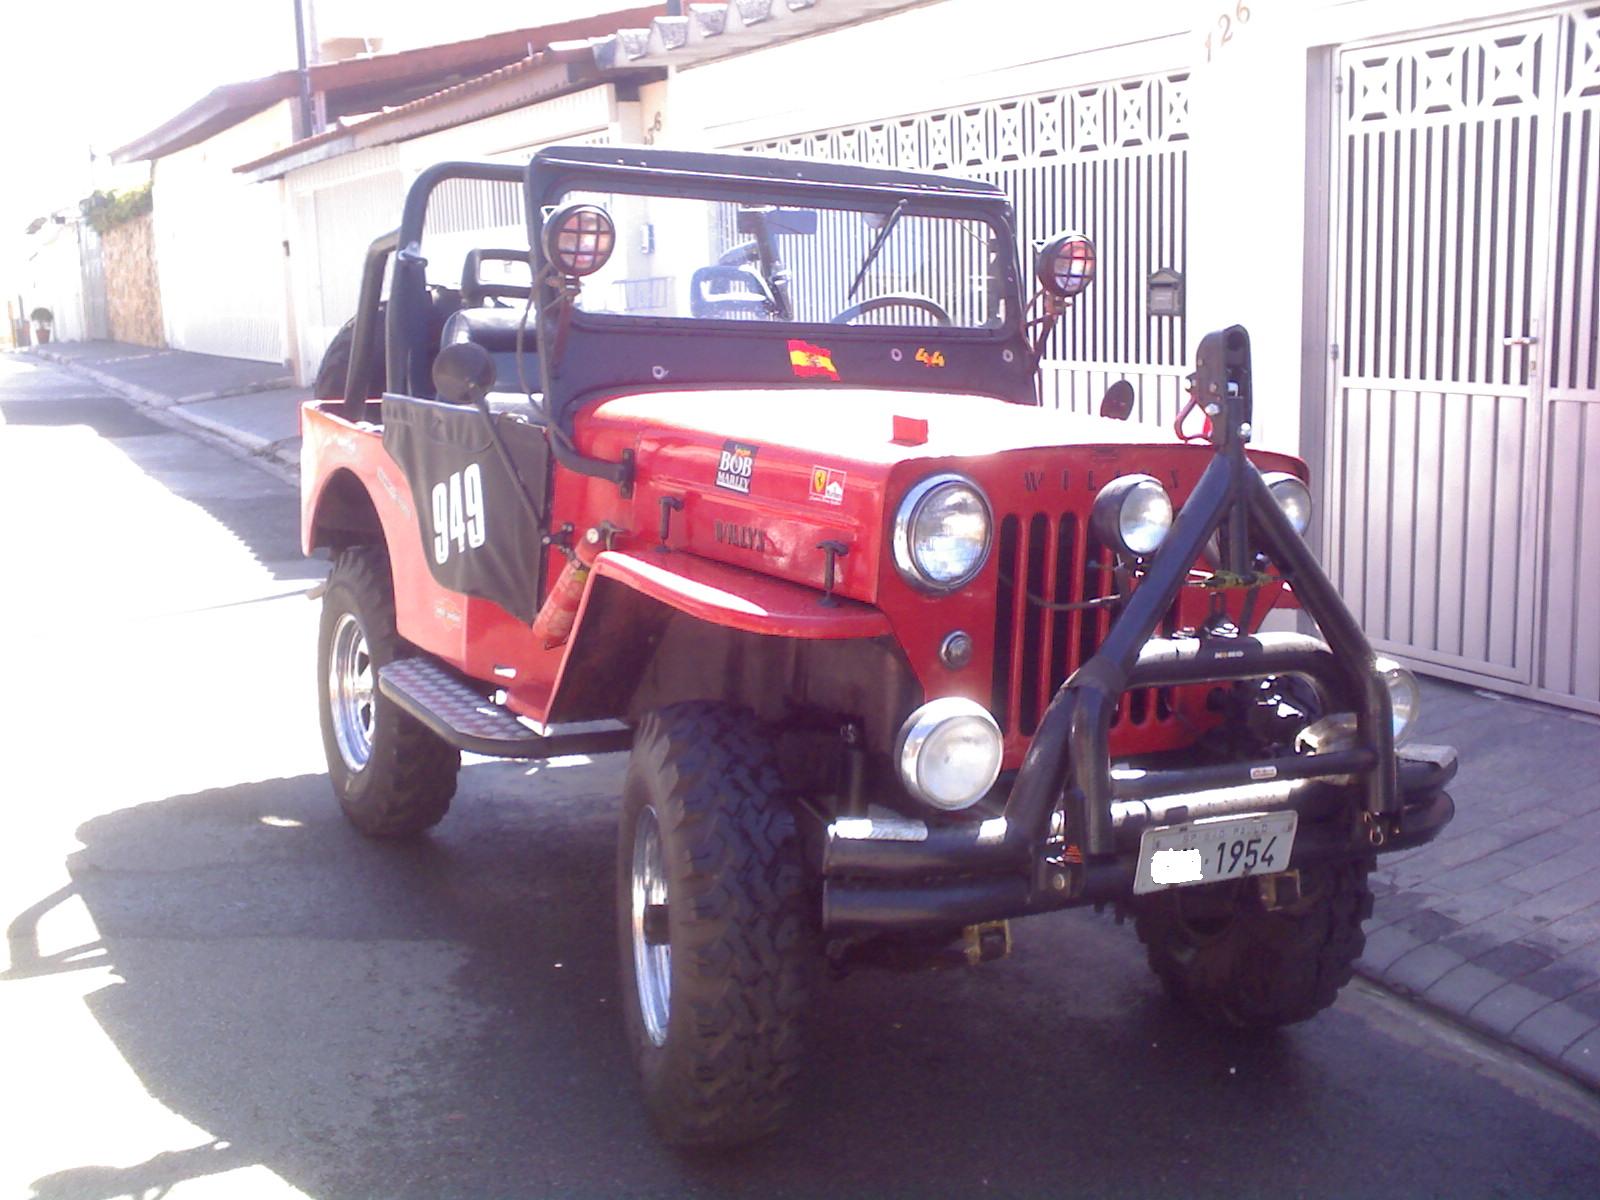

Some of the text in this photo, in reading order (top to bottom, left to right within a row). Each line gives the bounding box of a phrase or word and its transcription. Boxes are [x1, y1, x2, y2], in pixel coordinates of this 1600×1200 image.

[1204, 0, 1251, 64] 126
[716, 470, 751, 490] MARLEY
[718, 449, 753, 478] BOB
[431, 462, 486, 566] 949
[1216, 835, 1279, 875] 1954
